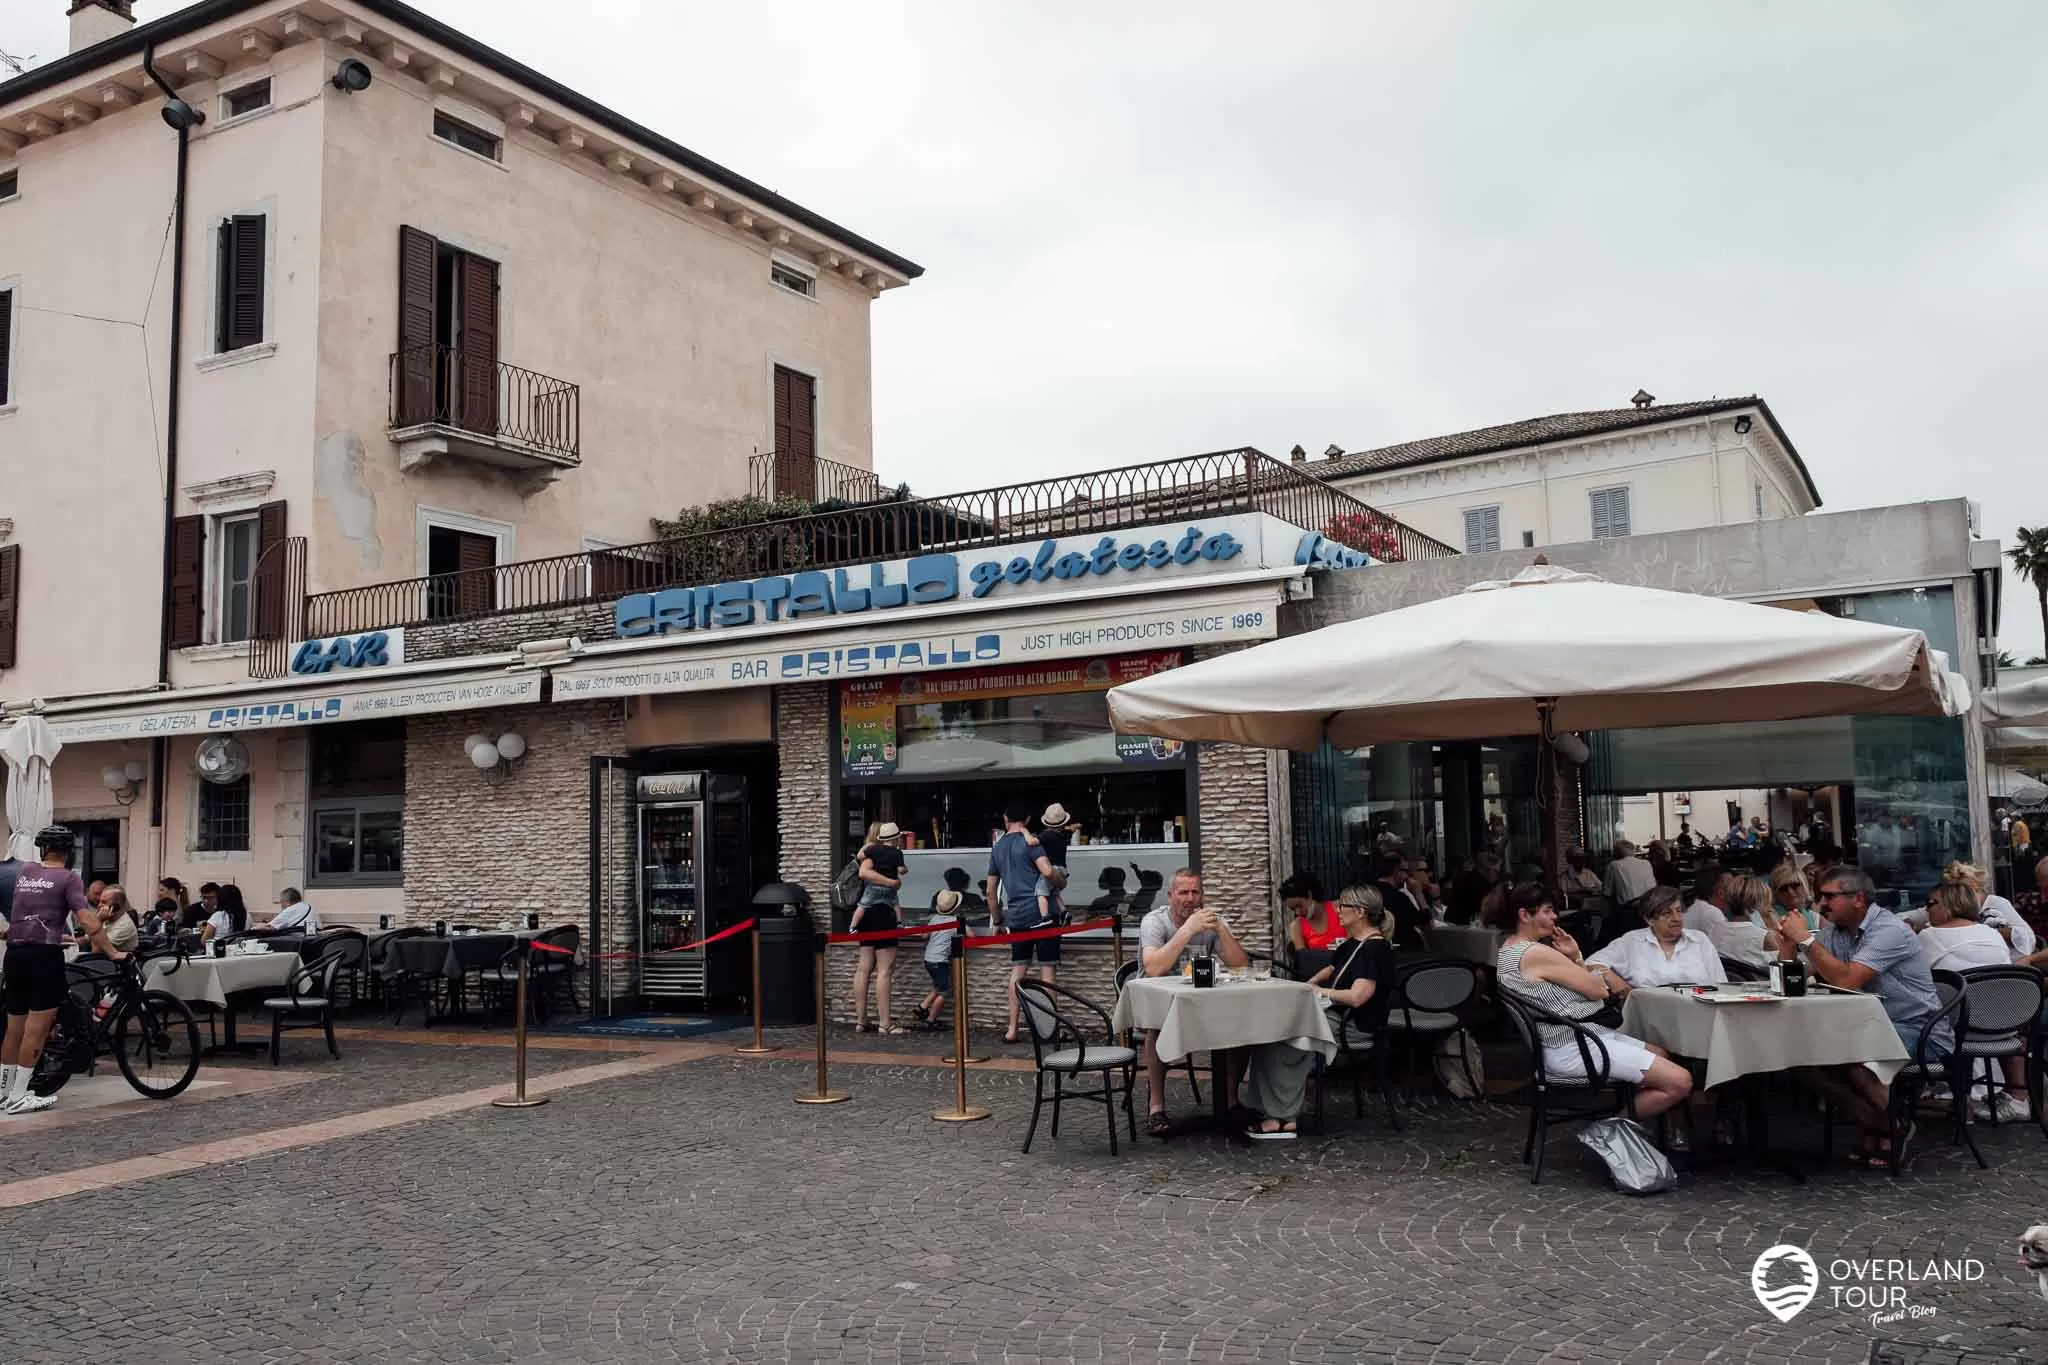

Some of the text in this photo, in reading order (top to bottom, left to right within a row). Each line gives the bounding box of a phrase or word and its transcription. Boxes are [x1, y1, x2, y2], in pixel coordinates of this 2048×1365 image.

[615, 552, 961, 637] CRISTALLO
[969, 526, 1243, 598] gelateria
[291, 632, 390, 674] BAR
[559, 680, 573, 691] DAL
[575, 679, 591, 690] 1969
[592, 677, 613, 689] SOLO
[615, 673, 650, 687] PRODOTTI
[653, 672, 661, 684] DI
[664, 671, 681, 683] ALTA
[731, 660, 769, 680] BAR
[781, 634, 1001, 678] CRISTALLO
[1020, 634, 1054, 650] JUST
[1059, 630, 1092, 647] HIGH
[1097, 621, 1175, 642] PRODUCTS
[1181, 617, 1224, 634] SINCE
[1231, 612, 1264, 629] 1969
[139, 715, 197, 732] GELATERIA
[208, 698, 342, 729] CRISTALLO
[389, 695, 414, 707] ALLEEN
[458, 689, 473, 700] VAN
